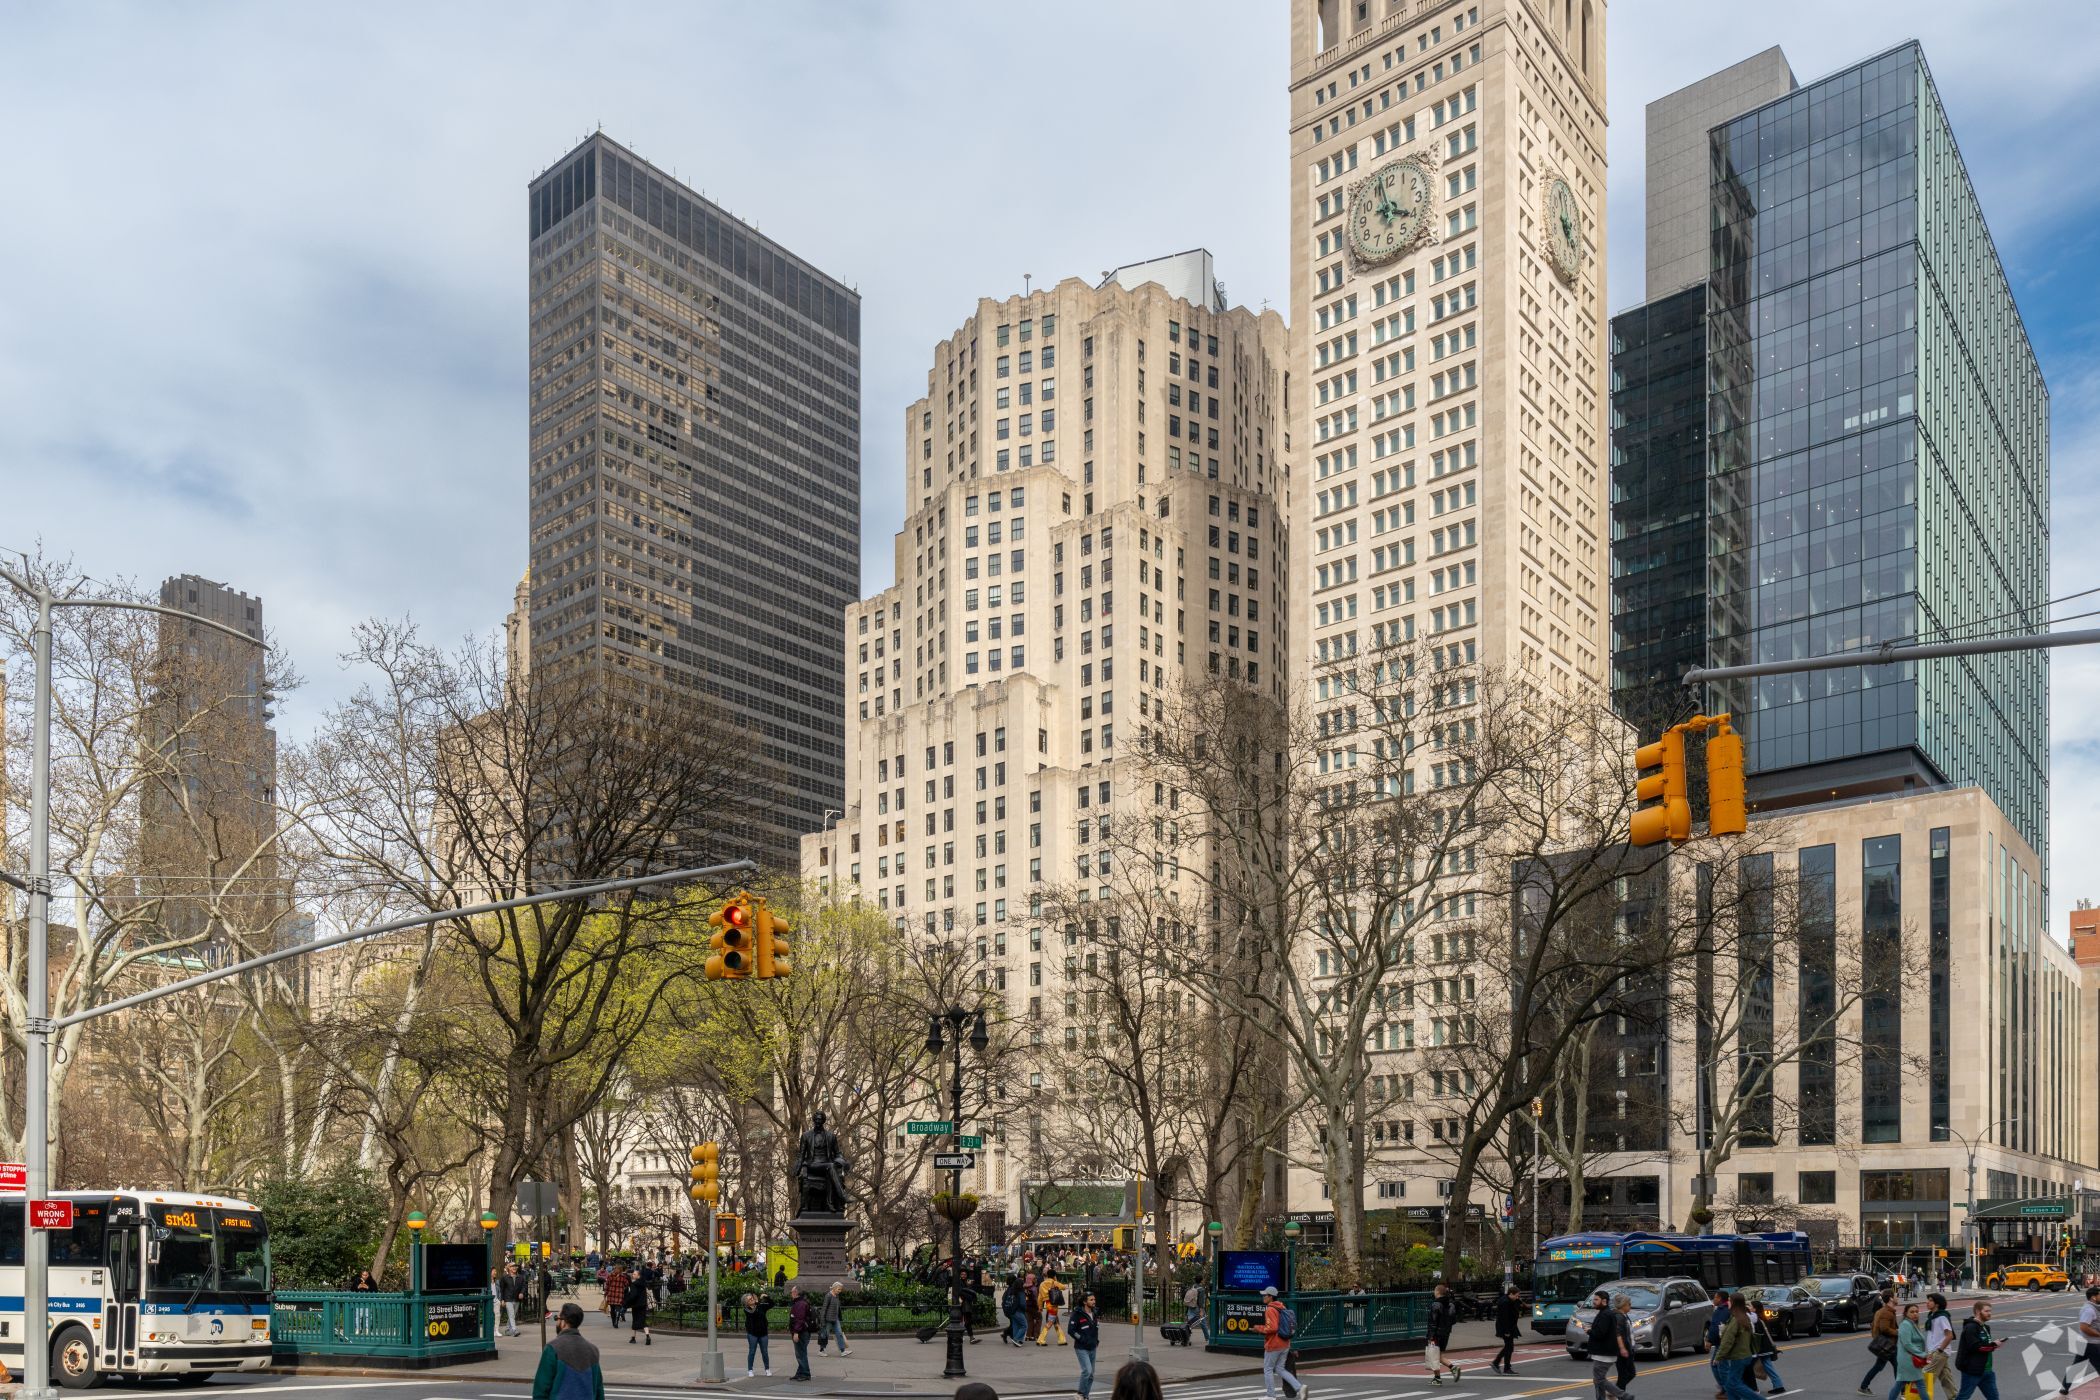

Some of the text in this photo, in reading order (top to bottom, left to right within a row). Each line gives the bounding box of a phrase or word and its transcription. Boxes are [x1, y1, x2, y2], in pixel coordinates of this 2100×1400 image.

[1386, 174, 1395, 188] 12
[1411, 178, 1417, 190] 2
[1415, 191, 1422, 203] 3
[1363, 200, 1372, 214] 10
[1410, 207, 1417, 218] 4
[1360, 217, 1366, 228] 9
[1363, 229, 1370, 241] 8
[1400, 223, 1407, 235] 5
[1374, 234, 1381, 247] 7
[1386, 233, 1394, 244] 6
[911, 1124, 949, 1133] Broadway
[962, 1137, 965, 1146] E
[967, 1138, 973, 1147] 23
[166, 1212, 198, 1228] SIM31
[274, 1303, 297, 1311] Subway
